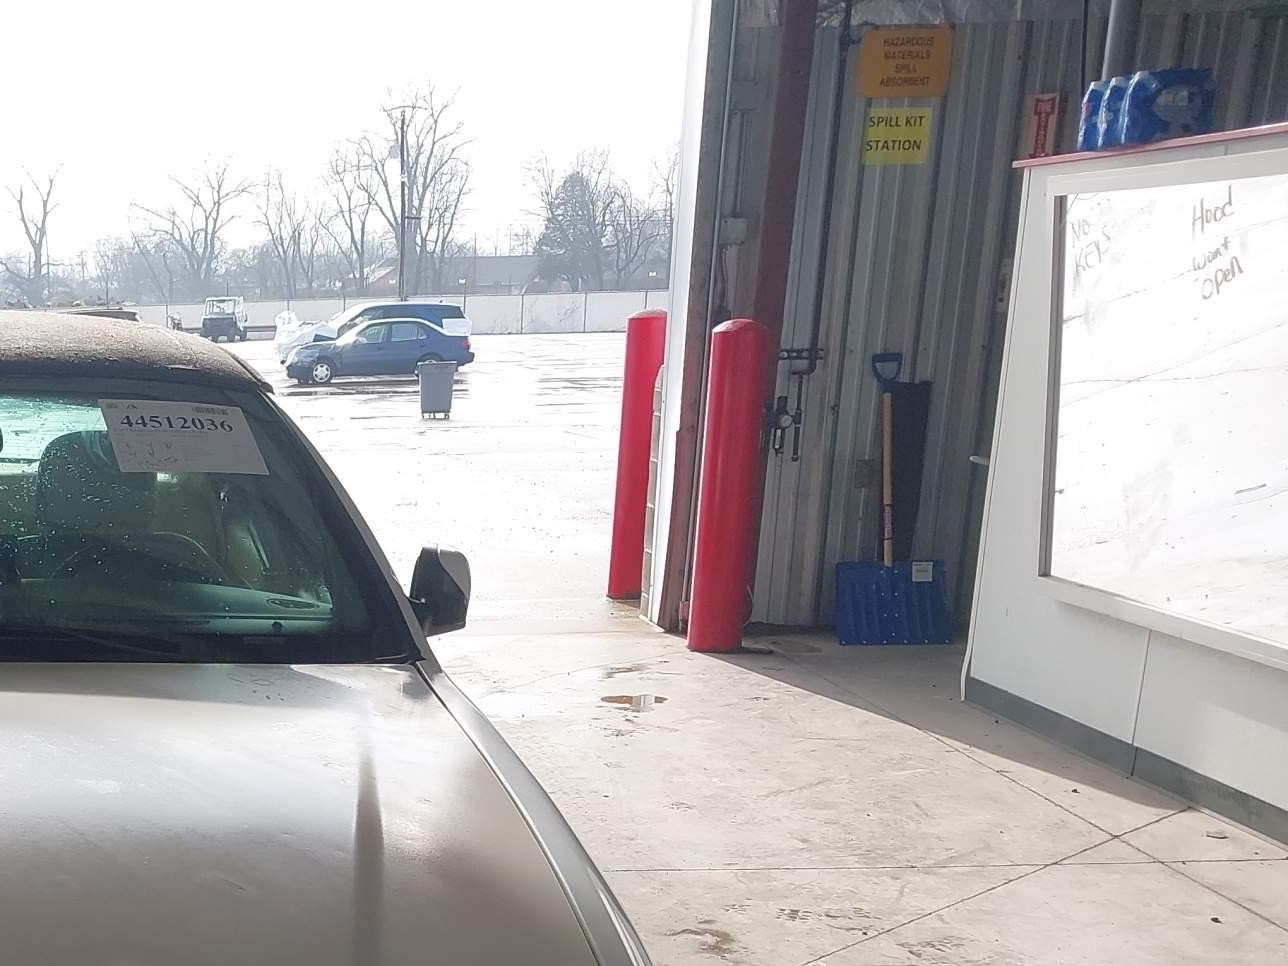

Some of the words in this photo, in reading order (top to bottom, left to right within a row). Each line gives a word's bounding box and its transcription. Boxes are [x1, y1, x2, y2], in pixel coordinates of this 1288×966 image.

[883, 37, 934, 47] HAZARDOUS
[884, 50, 930, 60] MATERIALS
[895, 63, 917, 73] SPILL
[880, 76, 930, 87] ABSORBENT
[869, 116, 901, 127] SPILL
[905, 115, 925, 127] KIT
[866, 139, 921, 151] STATION
[1192, 185, 1234, 240] Hood
[120, 415, 233, 432] 44512036
